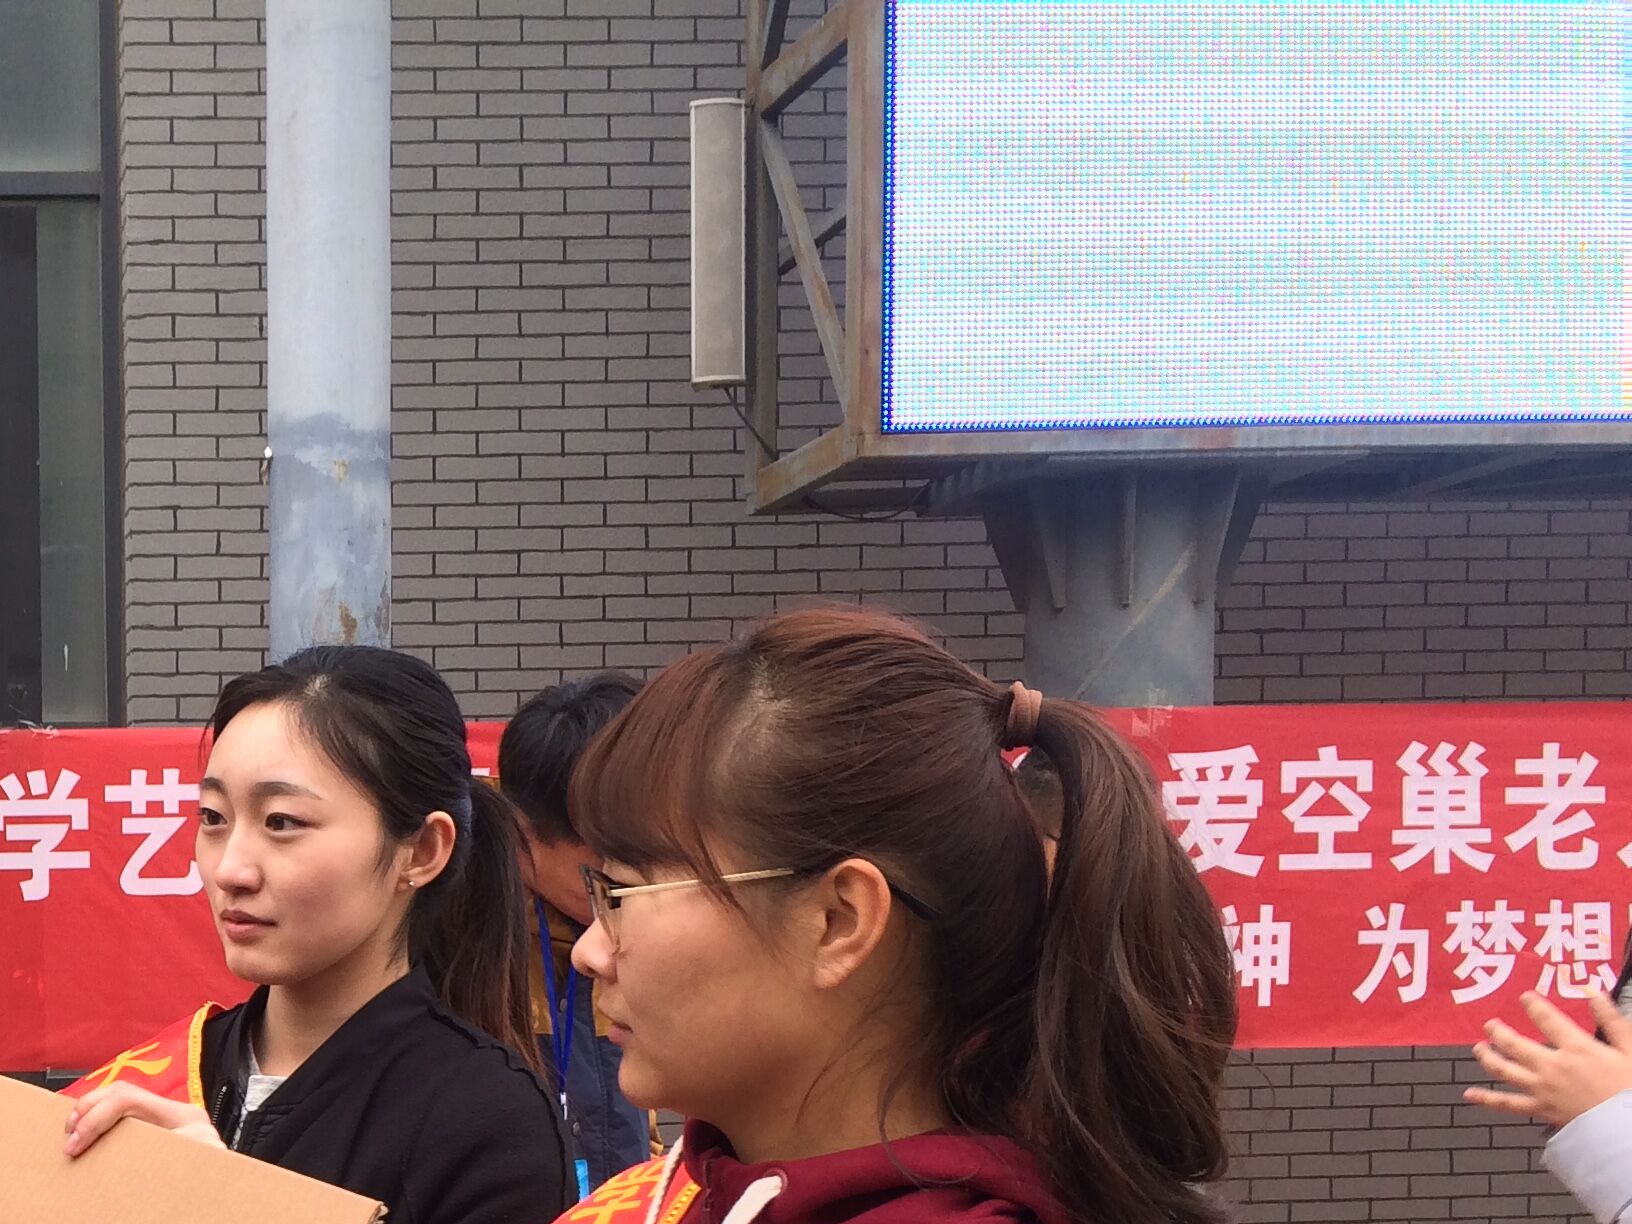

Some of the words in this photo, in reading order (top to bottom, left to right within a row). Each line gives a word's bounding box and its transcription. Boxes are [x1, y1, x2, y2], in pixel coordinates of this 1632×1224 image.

[1163, 739, 1632, 878] 爱空巢老
[1352, 899, 1619, 1005] 为梦想
